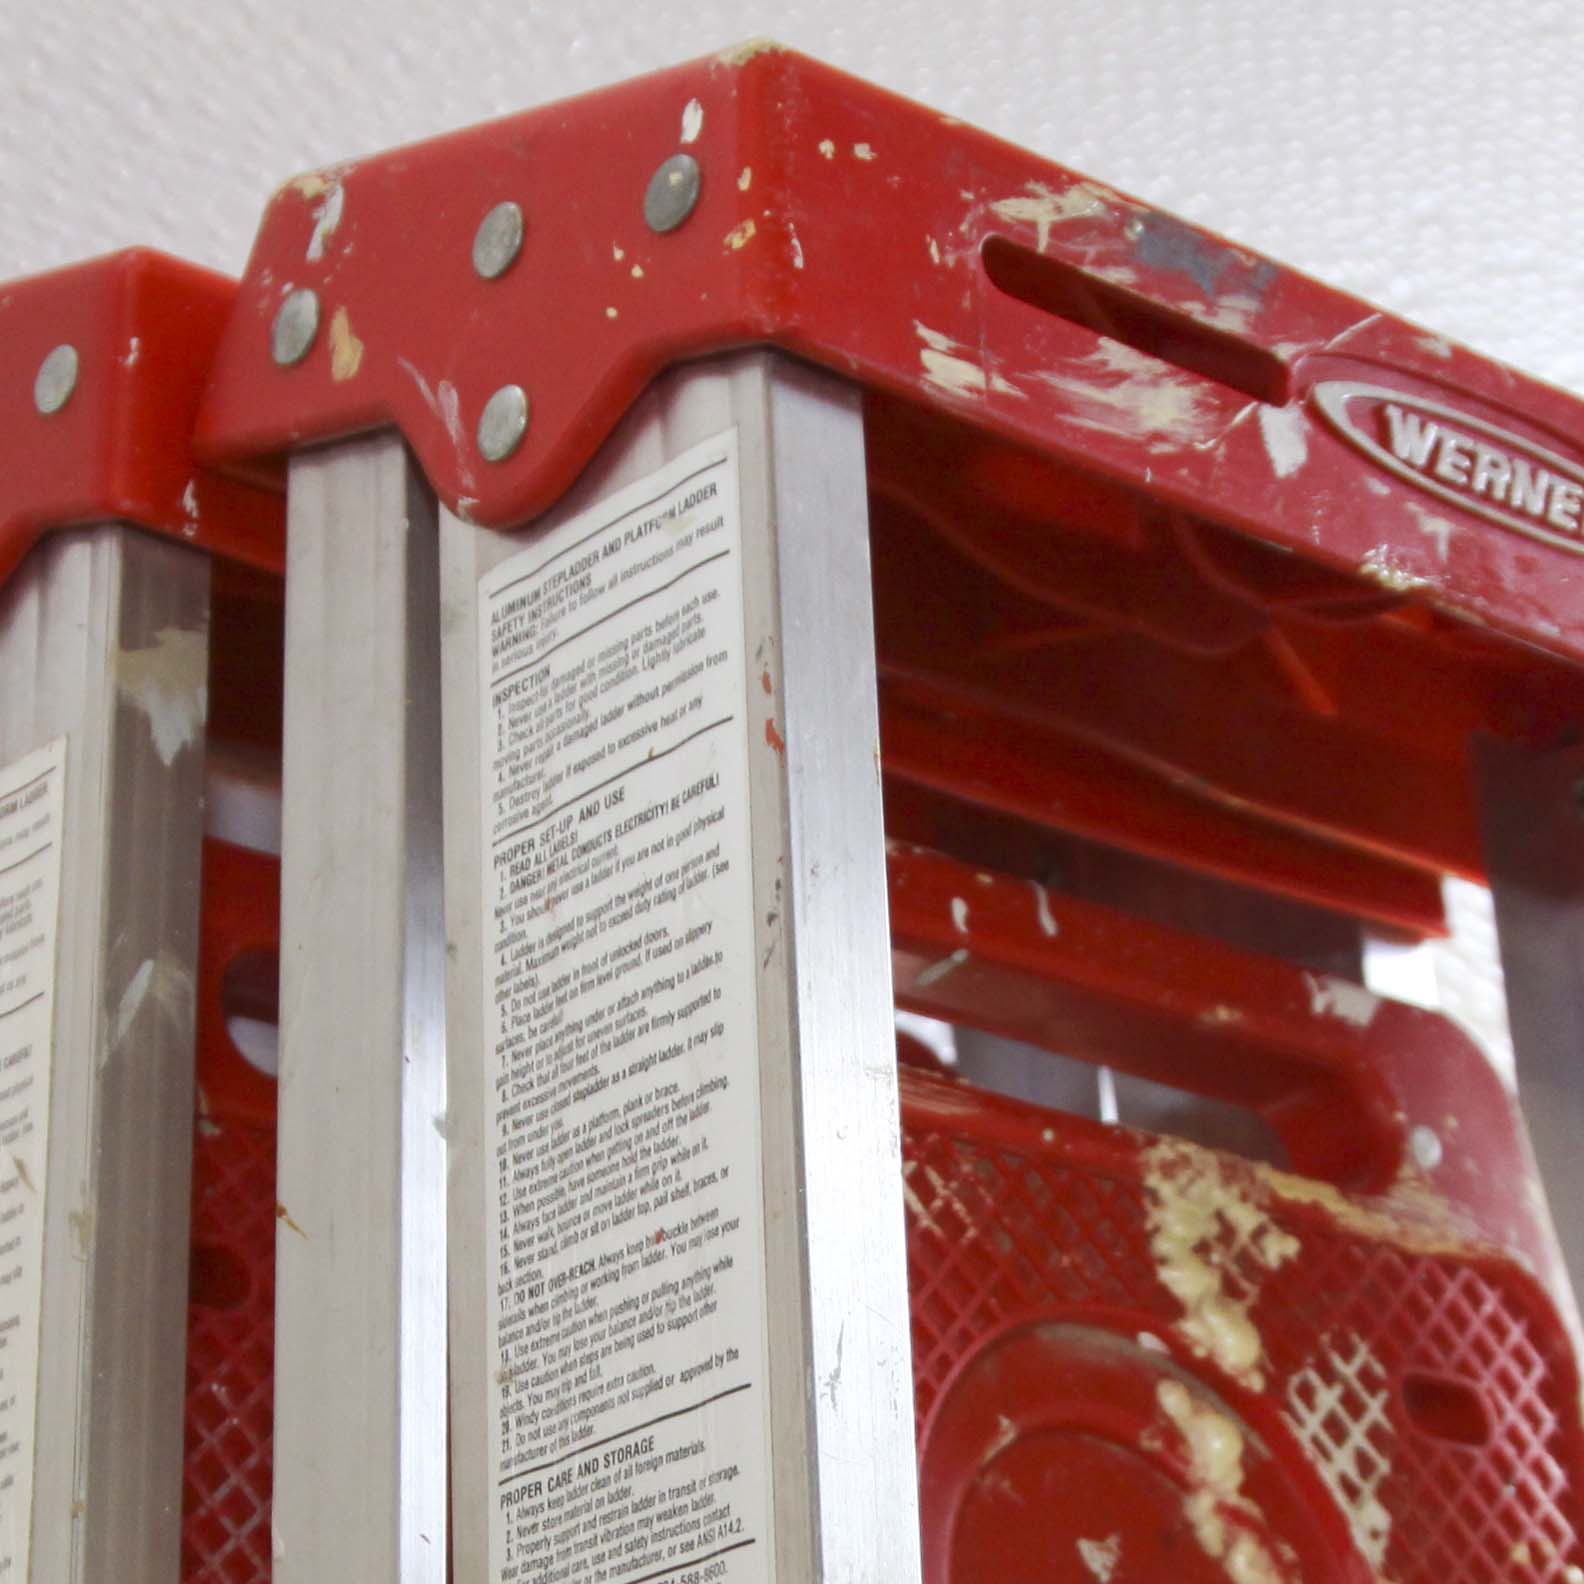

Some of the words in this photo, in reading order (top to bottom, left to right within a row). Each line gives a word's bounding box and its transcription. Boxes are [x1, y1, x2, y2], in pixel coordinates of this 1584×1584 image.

[491, 585, 540, 625] ALUMINUM
[543, 548, 599, 596] STEPLADDER
[602, 536, 621, 559] AND
[678, 481, 716, 516] LADDER
[620, 542, 673, 583] instructions
[696, 514, 723, 539] result
[492, 614, 523, 643] SAFETY
[528, 571, 591, 624] INSTRUCTIONS
[492, 663, 549, 707] INSPECTION
[628, 684, 659, 711] without
[661, 658, 703, 697] permission
[706, 647, 727, 668] from
[494, 836, 534, 870] PROPER
[539, 813, 573, 847] SET-UP
[578, 799, 600, 824] AND
[604, 785, 624, 810] USE
[571, 827, 612, 862] CONDUCTS
[615, 799, 668, 839] ELECTRICITY!
[682, 772, 719, 805] CAREFUL!
[509, 855, 530, 878] READ
[628, 1052, 656, 1079] straight
[529, 1281, 544, 1300] NOT
[500, 1480, 542, 1510] PROPER
[547, 1467, 573, 1492] CARE
[577, 1457, 599, 1480] AND
[603, 1435, 654, 1469] STORAGE
[668, 1479, 696, 1501] transit
[516, 1520, 539, 1539] Never
[651, 1515, 700, 1545] instructions
[656, 1501, 688, 1524] weaken
[679, 1536, 694, 1553] see
